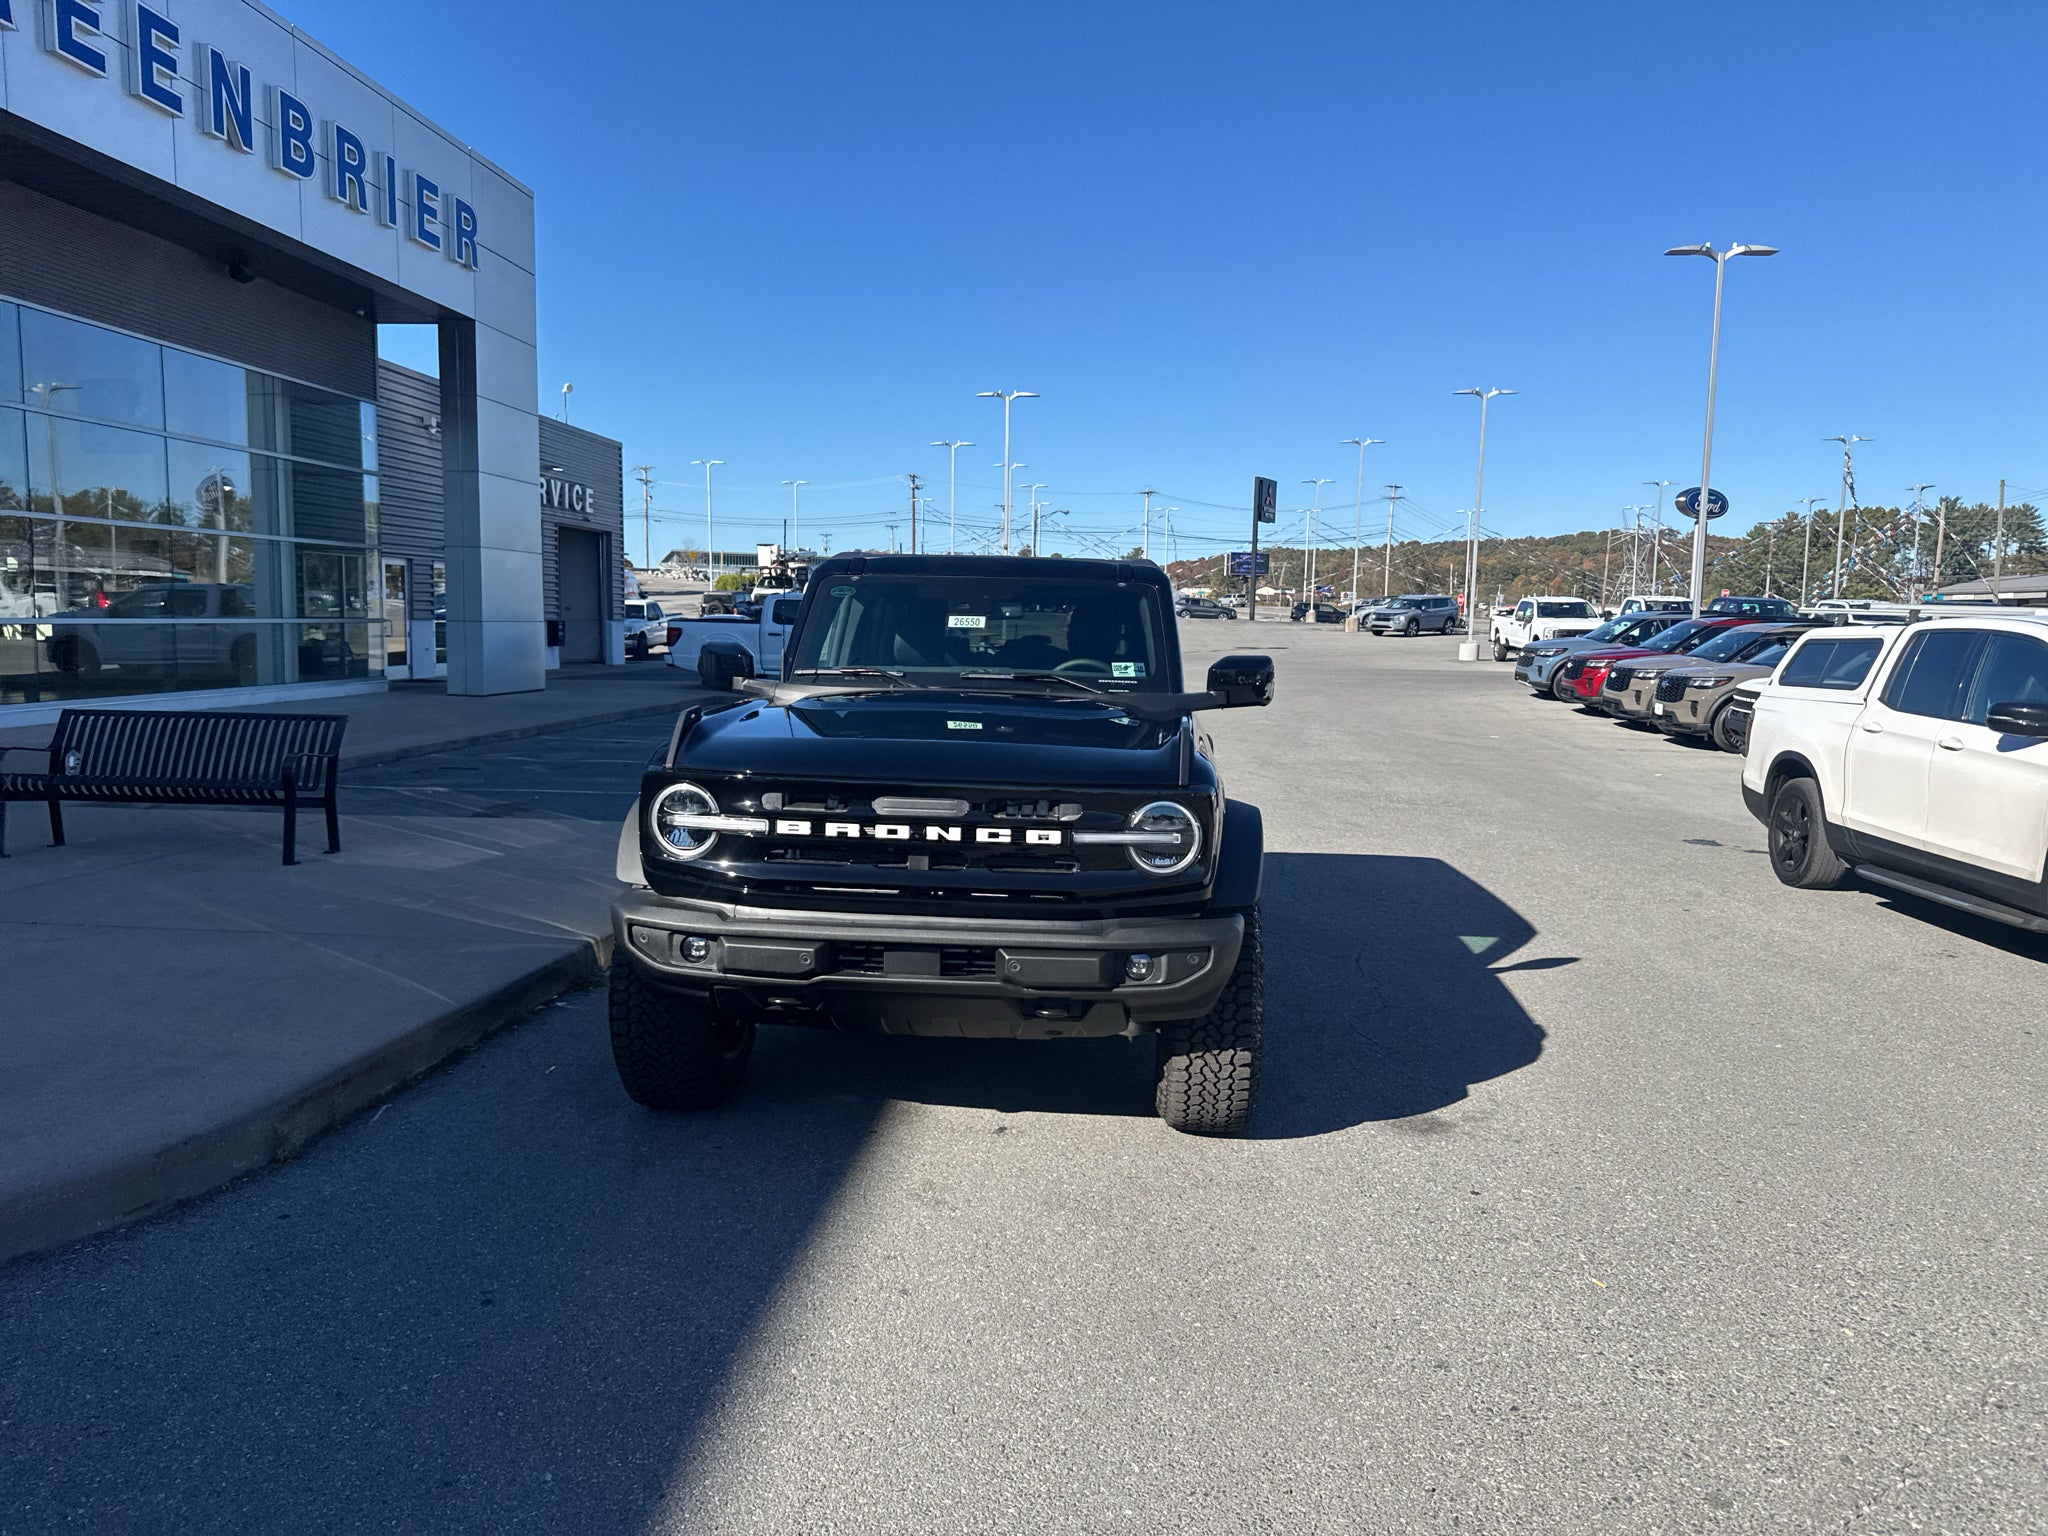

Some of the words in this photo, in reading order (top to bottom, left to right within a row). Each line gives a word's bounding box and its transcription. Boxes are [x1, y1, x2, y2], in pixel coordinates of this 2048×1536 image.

[0, 0, 479, 270] EENBRIER
[953, 617, 981, 627] 26550
[776, 819, 1062, 844] BRONCO
